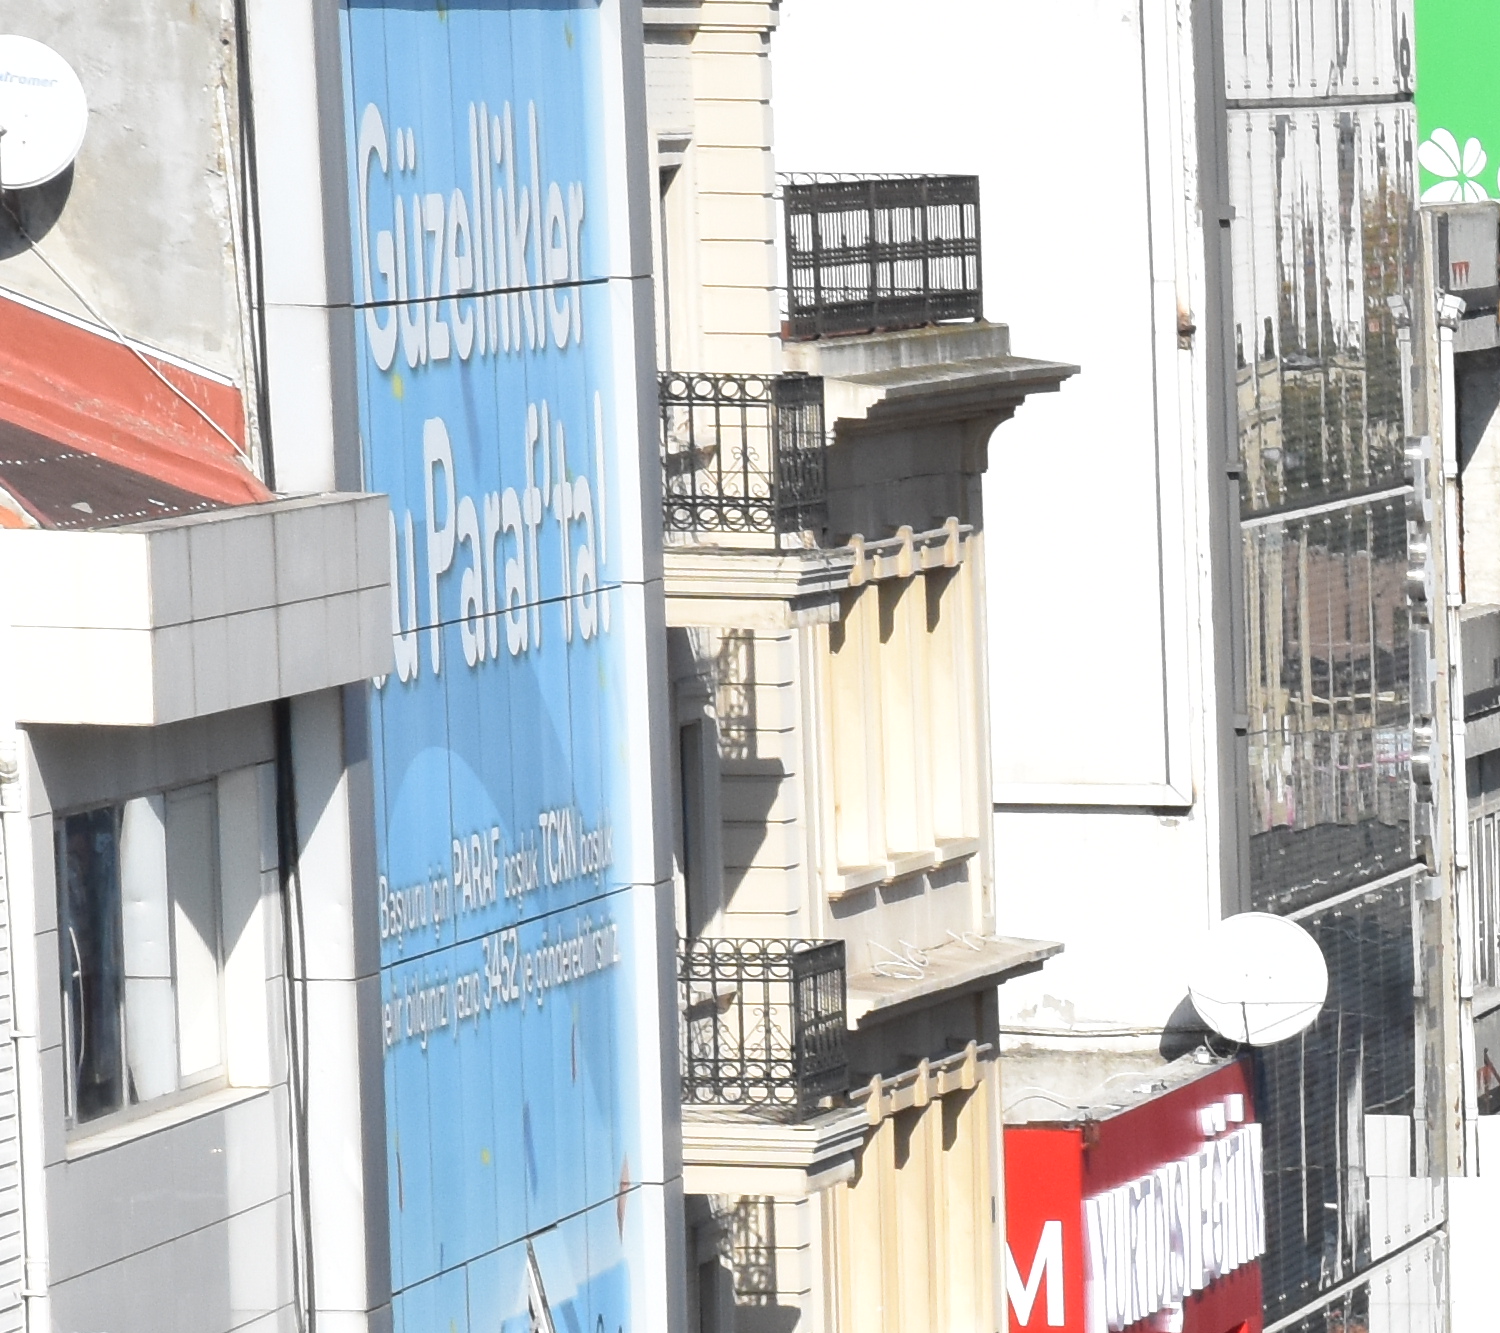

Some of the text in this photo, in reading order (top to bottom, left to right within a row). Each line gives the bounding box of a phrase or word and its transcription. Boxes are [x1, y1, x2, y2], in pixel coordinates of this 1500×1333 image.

[357, 101, 586, 371] Güzellikler
[423, 391, 612, 675] Paraf'ta!
[453, 826, 501, 918] PARAF
[539, 804, 578, 886] TCKN
